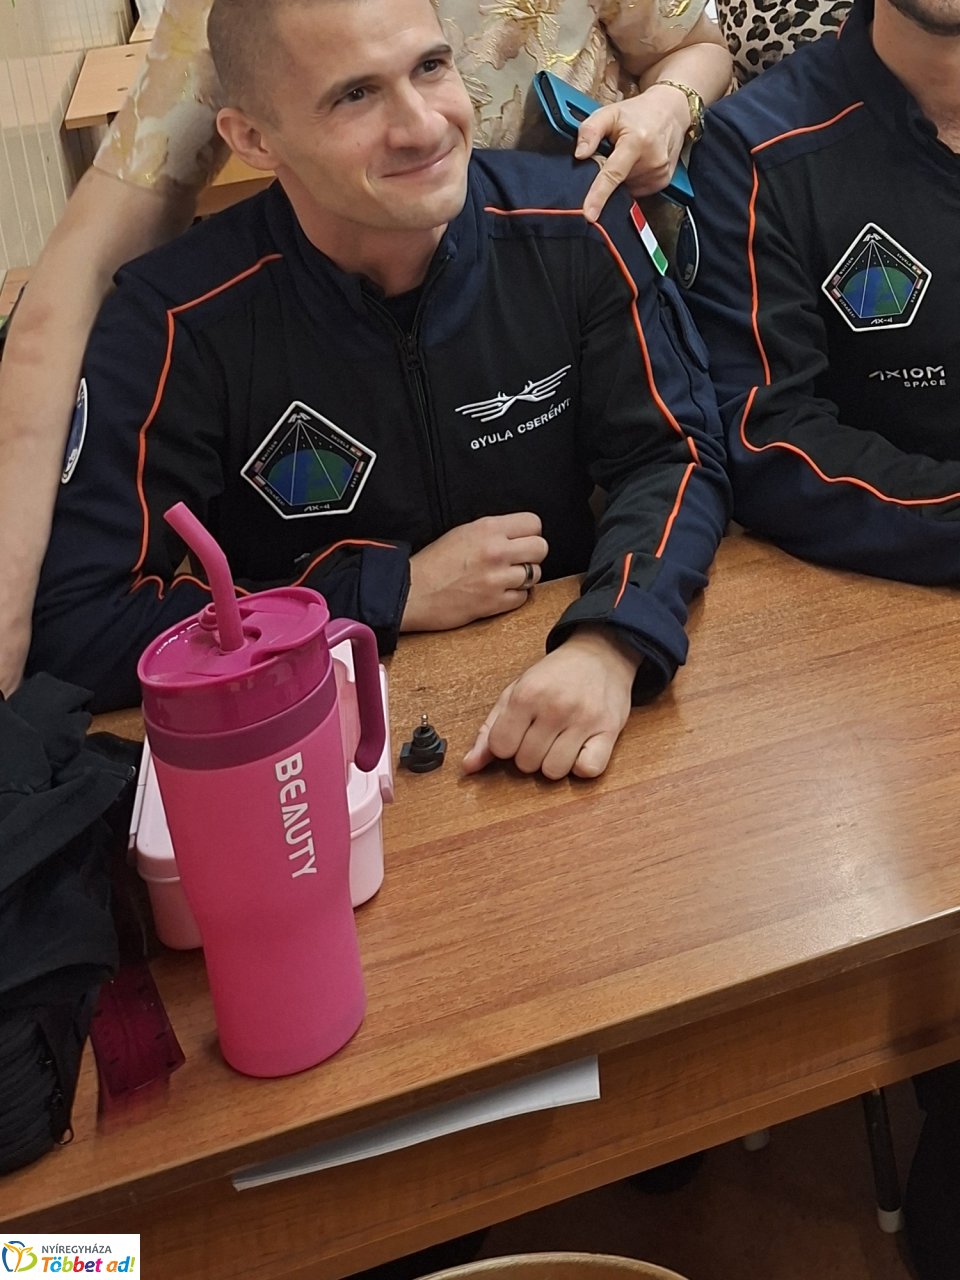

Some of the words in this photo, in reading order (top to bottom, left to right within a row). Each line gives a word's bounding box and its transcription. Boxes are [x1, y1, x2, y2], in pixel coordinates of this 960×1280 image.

[868, 365, 944, 381] AXIOM
[904, 380, 946, 388] SPACE
[470, 429, 514, 450] GYULA
[275, 751, 317, 878] BEAUTY
